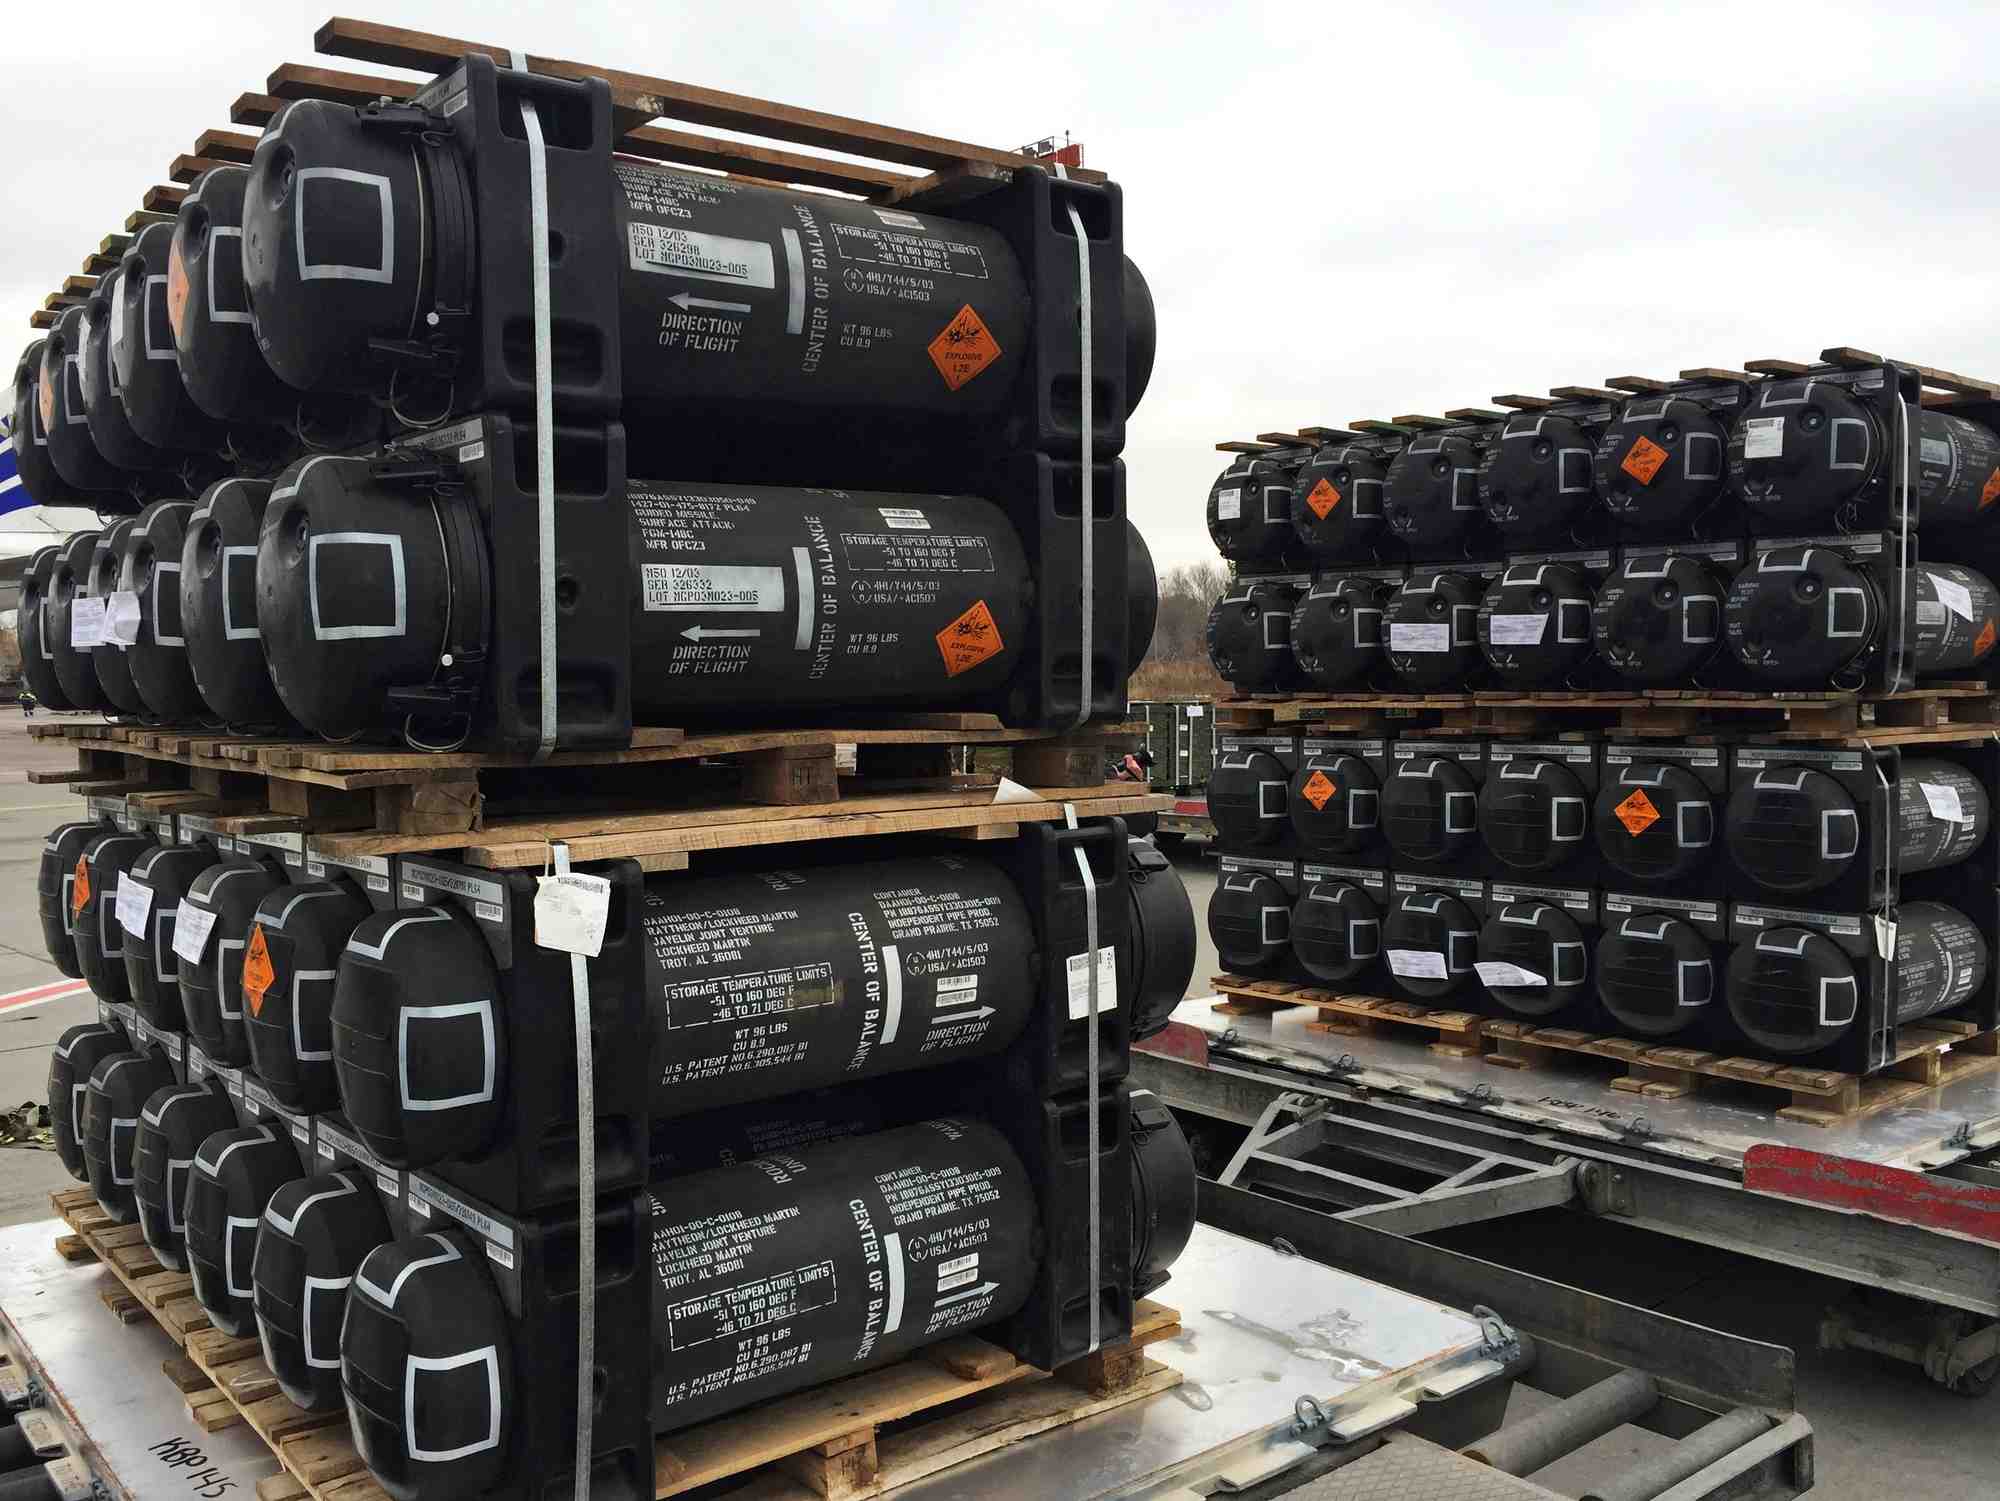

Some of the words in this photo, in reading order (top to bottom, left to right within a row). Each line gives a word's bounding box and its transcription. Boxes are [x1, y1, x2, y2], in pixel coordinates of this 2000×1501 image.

[633, 235, 655, 249] SER
[791, 204, 828, 269] BALANCE
[836, 226, 880, 240] STORAGE
[881, 231, 947, 251] TEMPERATURE
[635, 247, 655, 259] LOT
[890, 243, 905, 254] TO
[923, 248, 942, 260] DEG
[897, 255, 911, 266] TO
[912, 257, 922, 267] 71
[923, 258, 943, 269] DEG
[813, 276, 829, 299] OF
[662, 311, 742, 336] DIRECTION
[659, 331, 681, 346] OF
[684, 333, 740, 353] FLIGHT
[800, 306, 828, 373] CENTER
[638, 519, 689, 528] SURFACE
[645, 539, 669, 550] MFR
[803, 516, 837, 586] BALANCE
[845, 535, 890, 545] STORAGE
[891, 536, 954, 547] TEMPERATURE
[955, 538, 985, 548] LIMITS
[897, 547, 911, 557] TO
[913, 548, 929, 558] 160
[930, 548, 951, 559] DEG
[905, 558, 918, 568] TO
[919, 559, 930, 568] 71
[931, 559, 950, 569] DEG
[671, 567, 702, 578] 12/03
[647, 579, 669, 591] SER
[673, 579, 713, 591] 326332
[649, 590, 670, 603] LOT
[823, 593, 838, 614] OF
[849, 633, 864, 644] WT
[865, 633, 879, 644] 96
[880, 633, 900, 644] LBS
[672, 645, 752, 660] DIRECTION
[808, 622, 837, 680] CENTER
[846, 644, 860, 655] CU
[668, 661, 690, 674] OF
[693, 660, 749, 673] FLIGHT
[873, 887, 922, 900] CONTAINER
[646, 914, 760, 936] RAYTHEON/LOCKHEED
[760, 910, 800, 923] MARTIN
[887, 912, 945, 929] INDEPENDENT
[946, 910, 967, 921] PIPE
[892, 926, 922, 939] GRAND
[960, 920, 973, 931] TX
[973, 916, 1000, 929] 75052
[653, 932, 696, 947] JAVELIN
[698, 928, 727, 941] JOINT
[728, 921, 776, 938] VENTURE
[848, 911, 878, 974] CENTER
[655, 942, 711, 958] LOCKHEED
[711, 936, 752, 951] MARTIN
[696, 954, 710, 966] AL
[711, 949, 743, 963] 36081
[670, 982, 719, 1000] STORAGE
[722, 972, 794, 993] TEMPERATURE
[796, 967, 828, 982] LIMITS
[865, 980, 880, 1001] OF
[710, 995, 726, 1007] -51
[729, 992, 743, 1004] TO
[745, 989, 763, 1002] 160
[766, 987, 785, 999] DEG
[788, 985, 794, 996] F
[712, 1007, 731, 1019] -46
[734, 1004, 749, 1016] TO
[751, 1002, 761, 1014] 71
[764, 999, 784, 1012] DEG
[787, 998, 794, 1008] C
[735, 1028, 750, 1039] WT
[753, 1026, 766, 1037] 96
[769, 1022, 788, 1034] LBS
[846, 1008, 880, 1070] BALANCE
[925, 1020, 990, 1041] DIRECTION
[732, 1041, 747, 1051] CU
[920, 1040, 938, 1052] OF
[939, 1032, 985, 1049] FLIGHT
[665, 1063, 683, 1074] U.S.
[688, 1055, 728, 1070] PATENT
[685, 1066, 725, 1081] PATENT
[873, 1165, 922, 1184] CONTAINER
[889, 1191, 946, 1215] INDEPENDENT
[946, 1186, 967, 1200] PIPE
[893, 1209, 924, 1226] GRAND
[961, 1196, 974, 1208] TX
[974, 1189, 1001, 1204] 75052
[762, 1205, 800, 1223] MARTIN
[848, 1198, 881, 1265] CENTER
[656, 1244, 698, 1264] JAVELIN
[701, 1235, 729, 1252] JOINT
[731, 1223, 777, 1244] VENTURE
[658, 1253, 713, 1277] LOCKHEED
[714, 1242, 753, 1261] MARTIN
[699, 1268, 712, 1281] AL
[713, 1257, 745, 1276] 36081
[868, 1269, 883, 1291] OF
[673, 1296, 722, 1320] STORAGE
[724, 1275, 796, 1306] TEMPERATURE
[798, 1266, 830, 1284] LIMITS
[713, 1308, 729, 1321] -51
[732, 1304, 745, 1317] TO
[749, 1299, 766, 1312] 160
[769, 1292, 788, 1306] DEG
[790, 1288, 797, 1299] F
[929, 1295, 993, 1324] DIRECTION
[715, 1320, 734, 1333] -46
[738, 1316, 751, 1328] TO
[753, 1311, 764, 1324] 71
[767, 1305, 786, 1320] DEG
[789, 1302, 797, 1313] C
[925, 1321, 943, 1334] OF
[944, 1306, 988, 1329] FLIGHT
[737, 1338, 753, 1352] WT
[756, 1333, 769, 1347] 96
[772, 1327, 792, 1342] LBS
[853, 1297, 884, 1361] BALANCE
[736, 1350, 751, 1363] CU
[669, 1382, 688, 1395] U.S.
[691, 1367, 733, 1388] PATENT
[689, 1377, 730, 1398] PATENT
